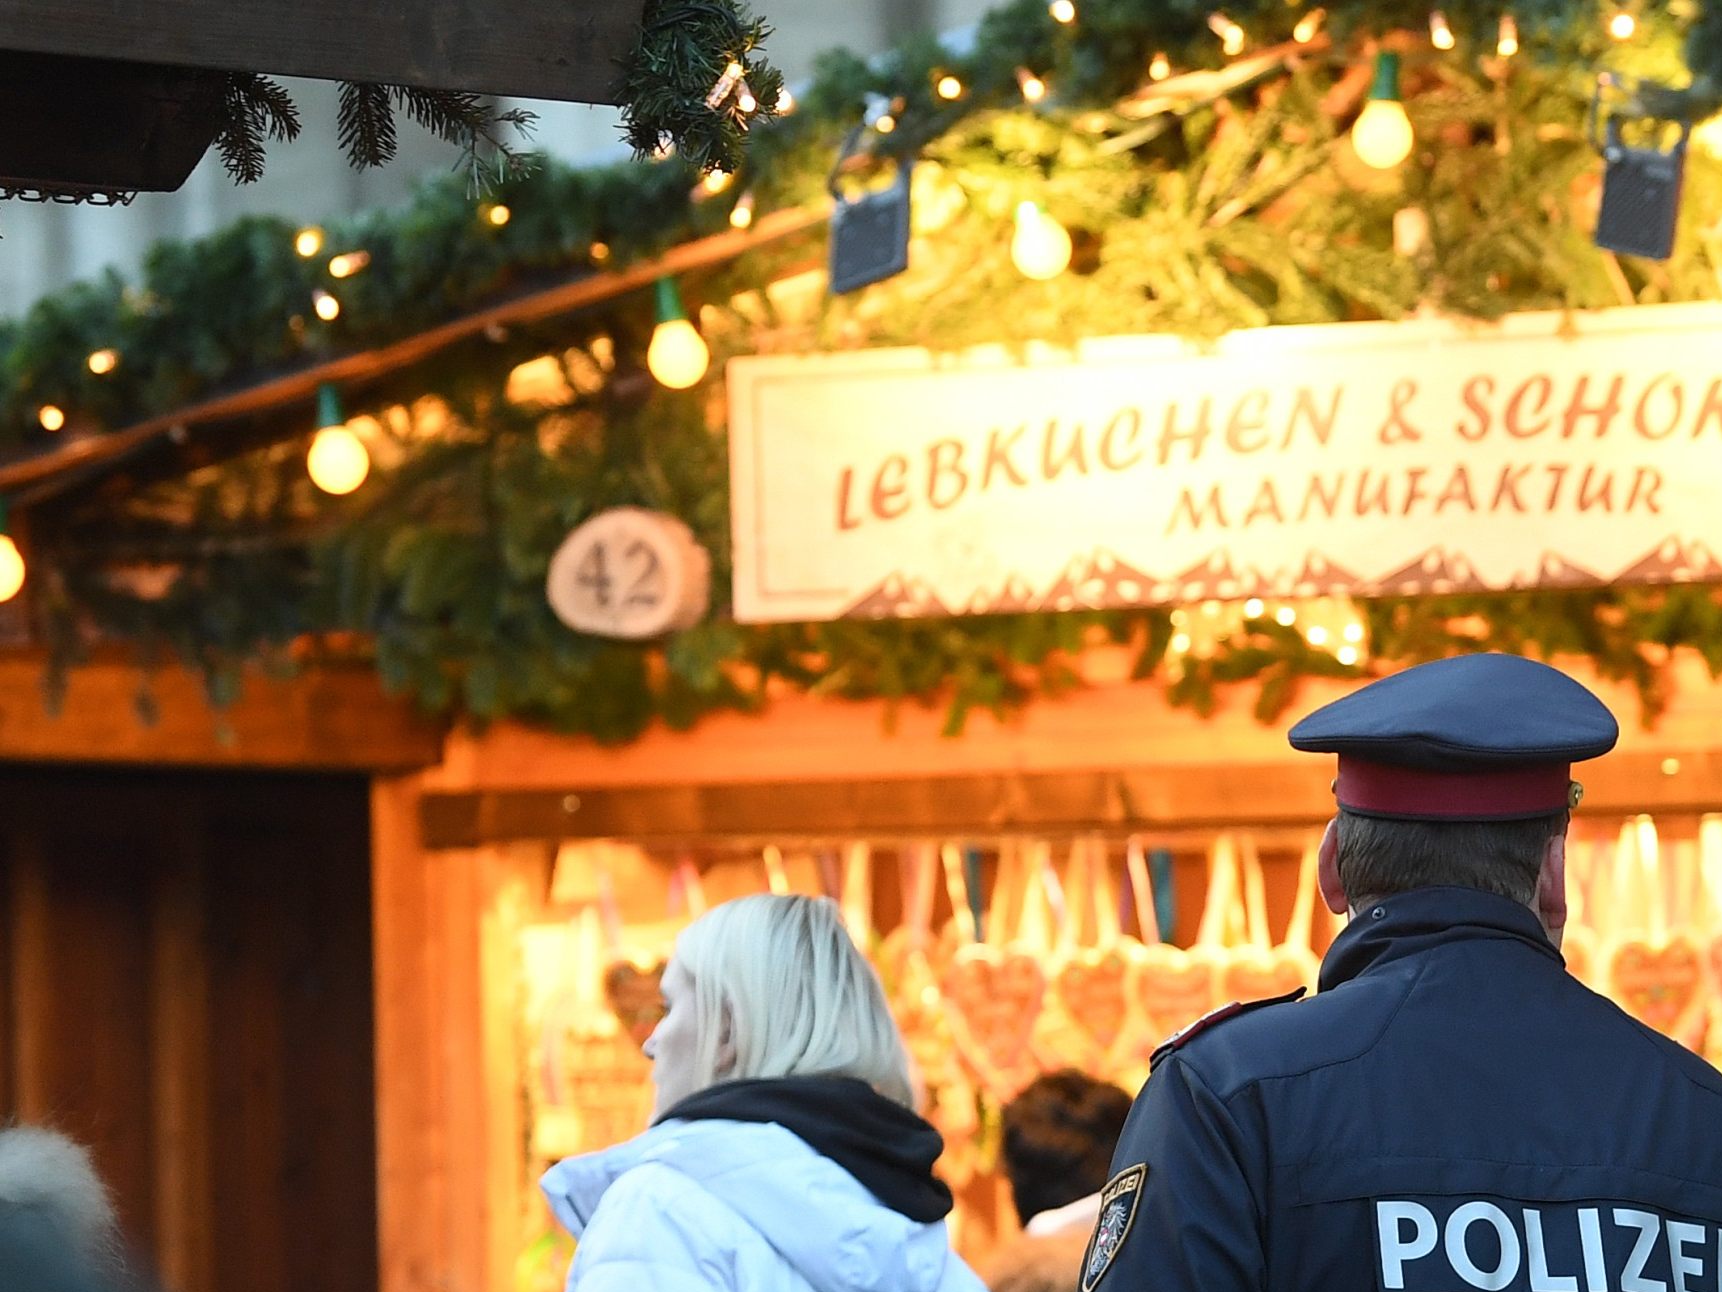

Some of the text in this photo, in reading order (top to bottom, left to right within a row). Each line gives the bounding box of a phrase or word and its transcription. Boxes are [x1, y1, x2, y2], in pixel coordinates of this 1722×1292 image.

[834, 384, 1344, 532] LEBKUCHEN
[1377, 368, 1423, 447] &
[1163, 463, 1665, 535] MANUFAKTUR
[573, 539, 662, 606] 42
